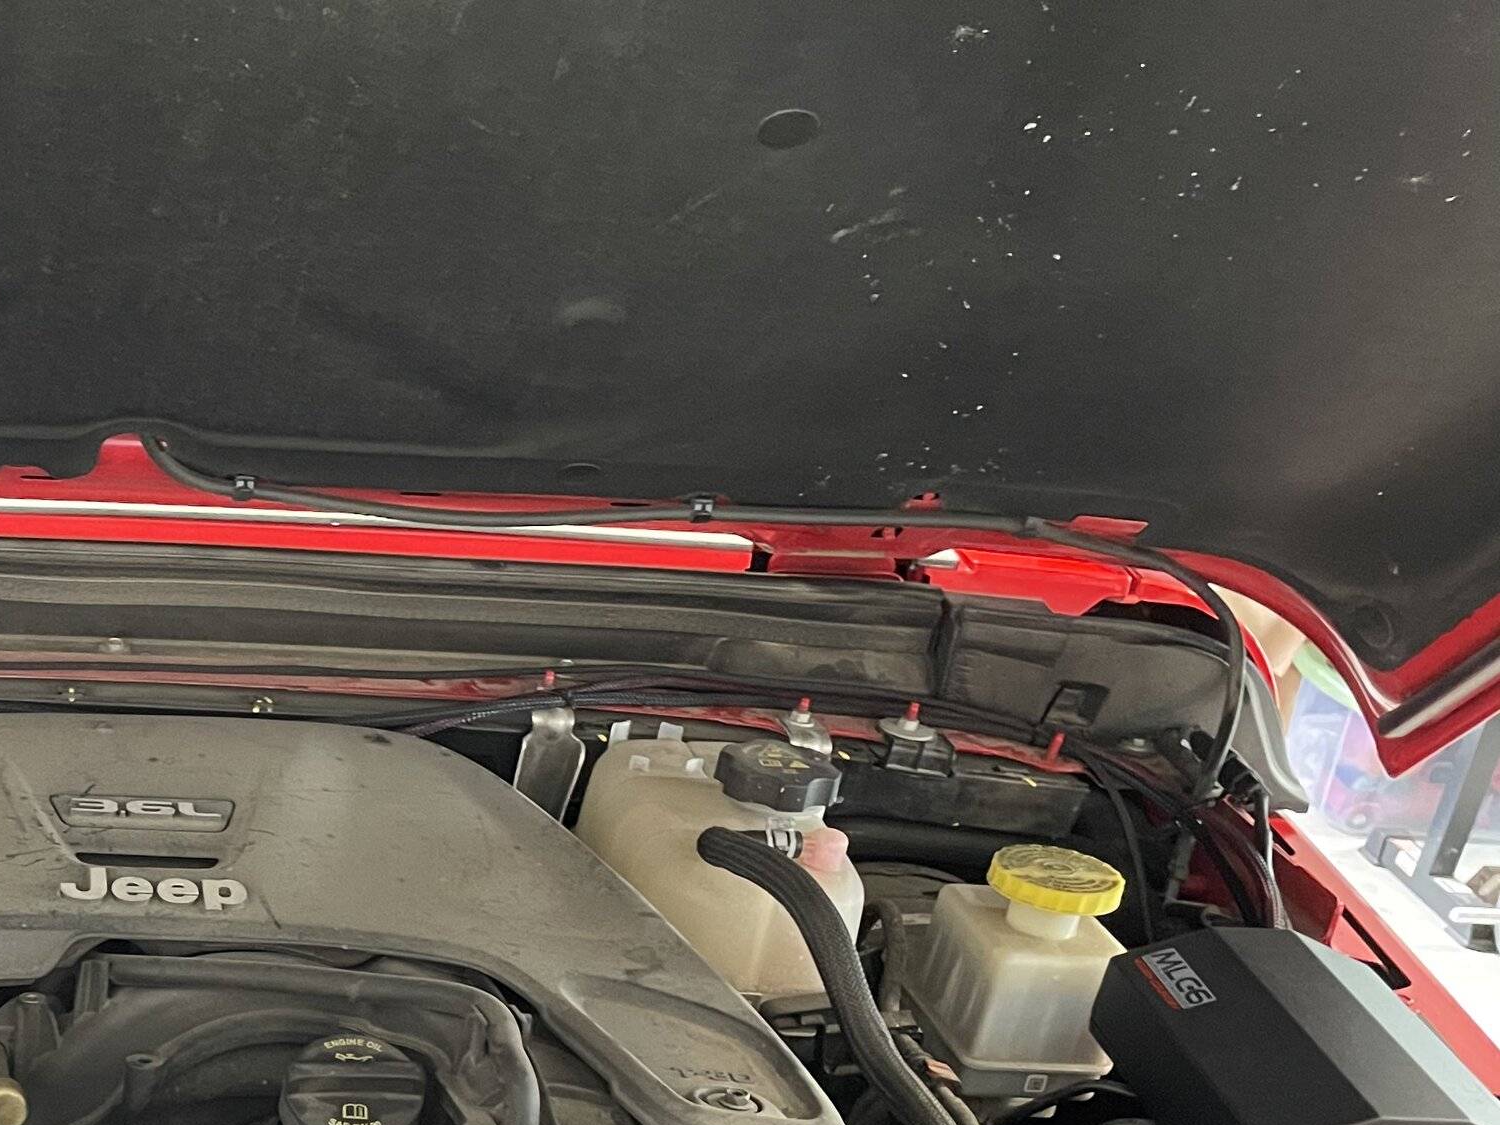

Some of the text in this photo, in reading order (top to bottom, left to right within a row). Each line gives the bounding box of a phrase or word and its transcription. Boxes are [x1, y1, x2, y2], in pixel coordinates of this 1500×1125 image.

[70, 797, 222, 818] 3.6L
[59, 866, 248, 911] Jeep
[323, 1038, 383, 1053] ENGINE OIL
